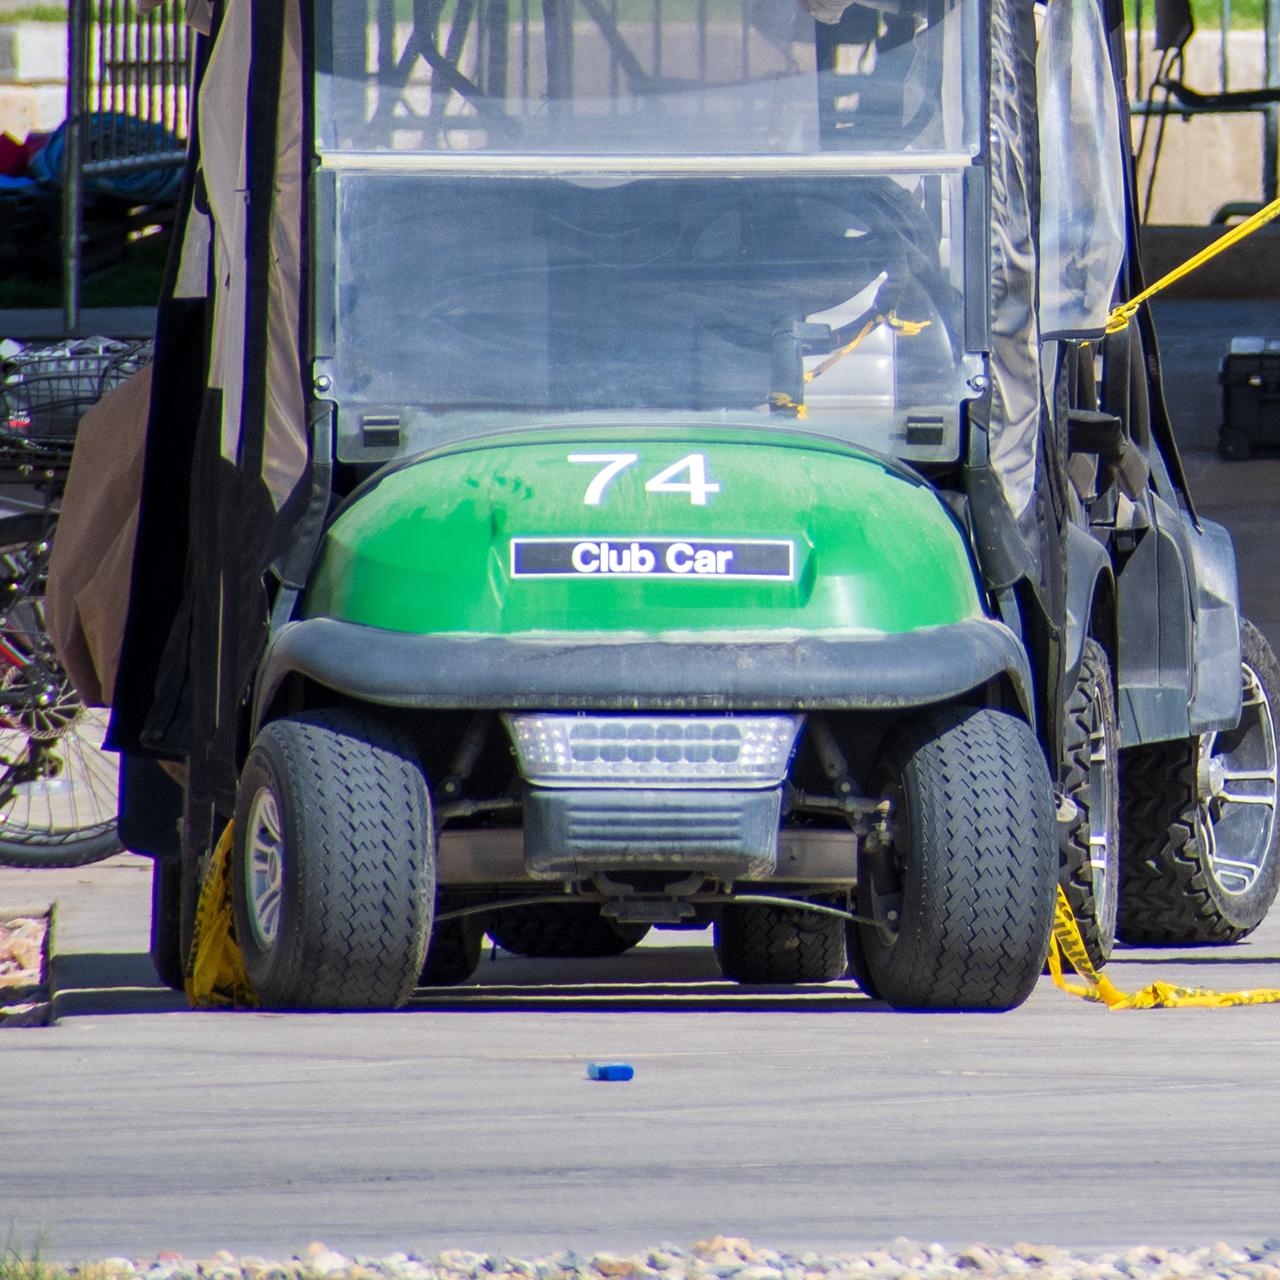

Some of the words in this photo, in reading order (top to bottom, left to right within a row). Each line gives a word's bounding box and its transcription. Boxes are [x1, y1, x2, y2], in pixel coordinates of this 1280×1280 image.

[567, 453, 720, 506] 74
[571, 542, 655, 573] Club
[665, 543, 733, 573] Car
